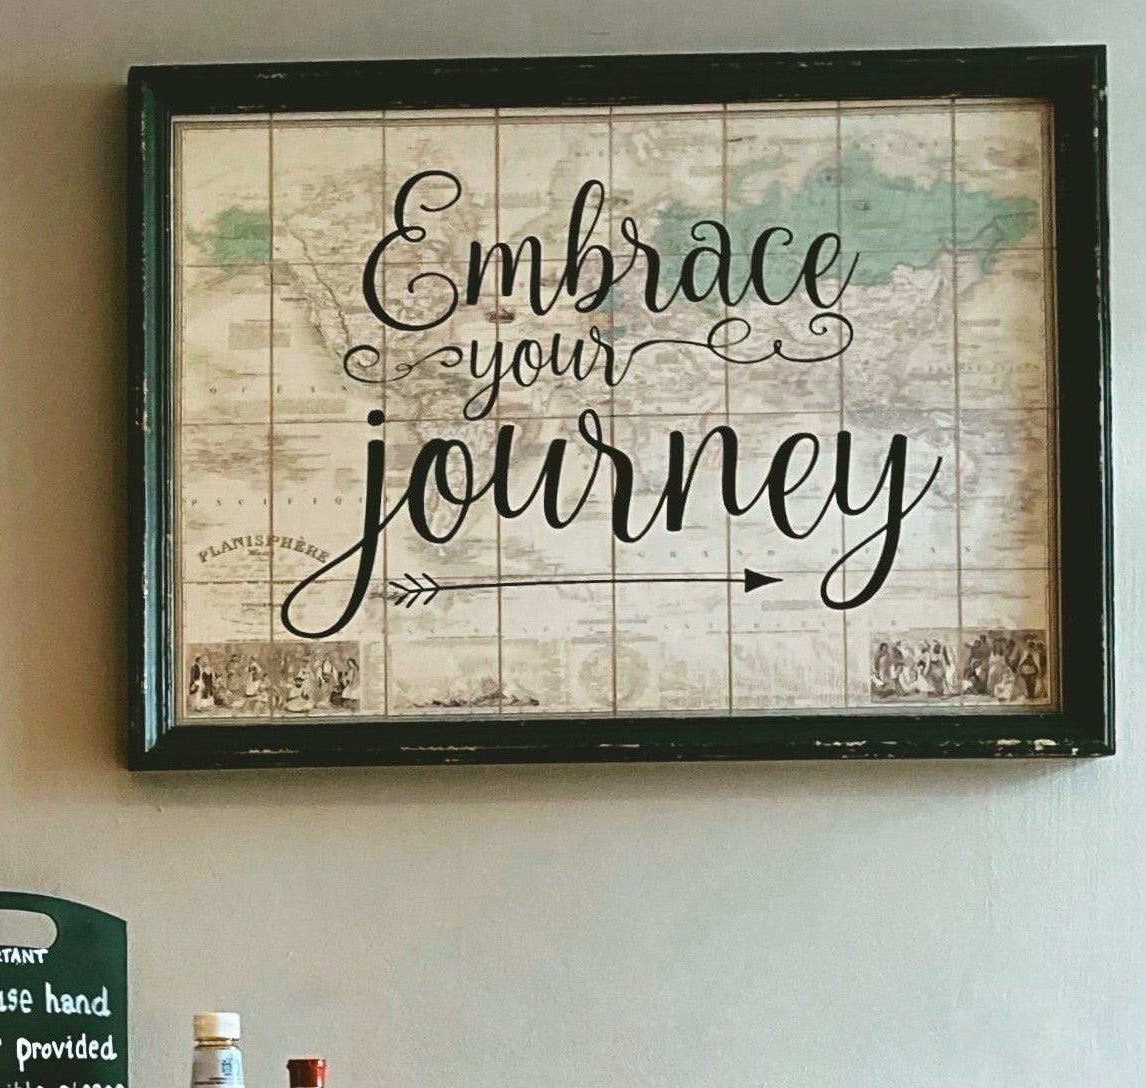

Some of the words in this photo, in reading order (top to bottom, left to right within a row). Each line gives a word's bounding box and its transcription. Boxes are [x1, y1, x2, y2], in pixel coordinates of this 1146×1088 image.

[362, 170, 860, 332] Embrace
[280, 408, 944, 639] journey
[44, 981, 112, 1018] hand
[16, 1032, 118, 1073] provided
